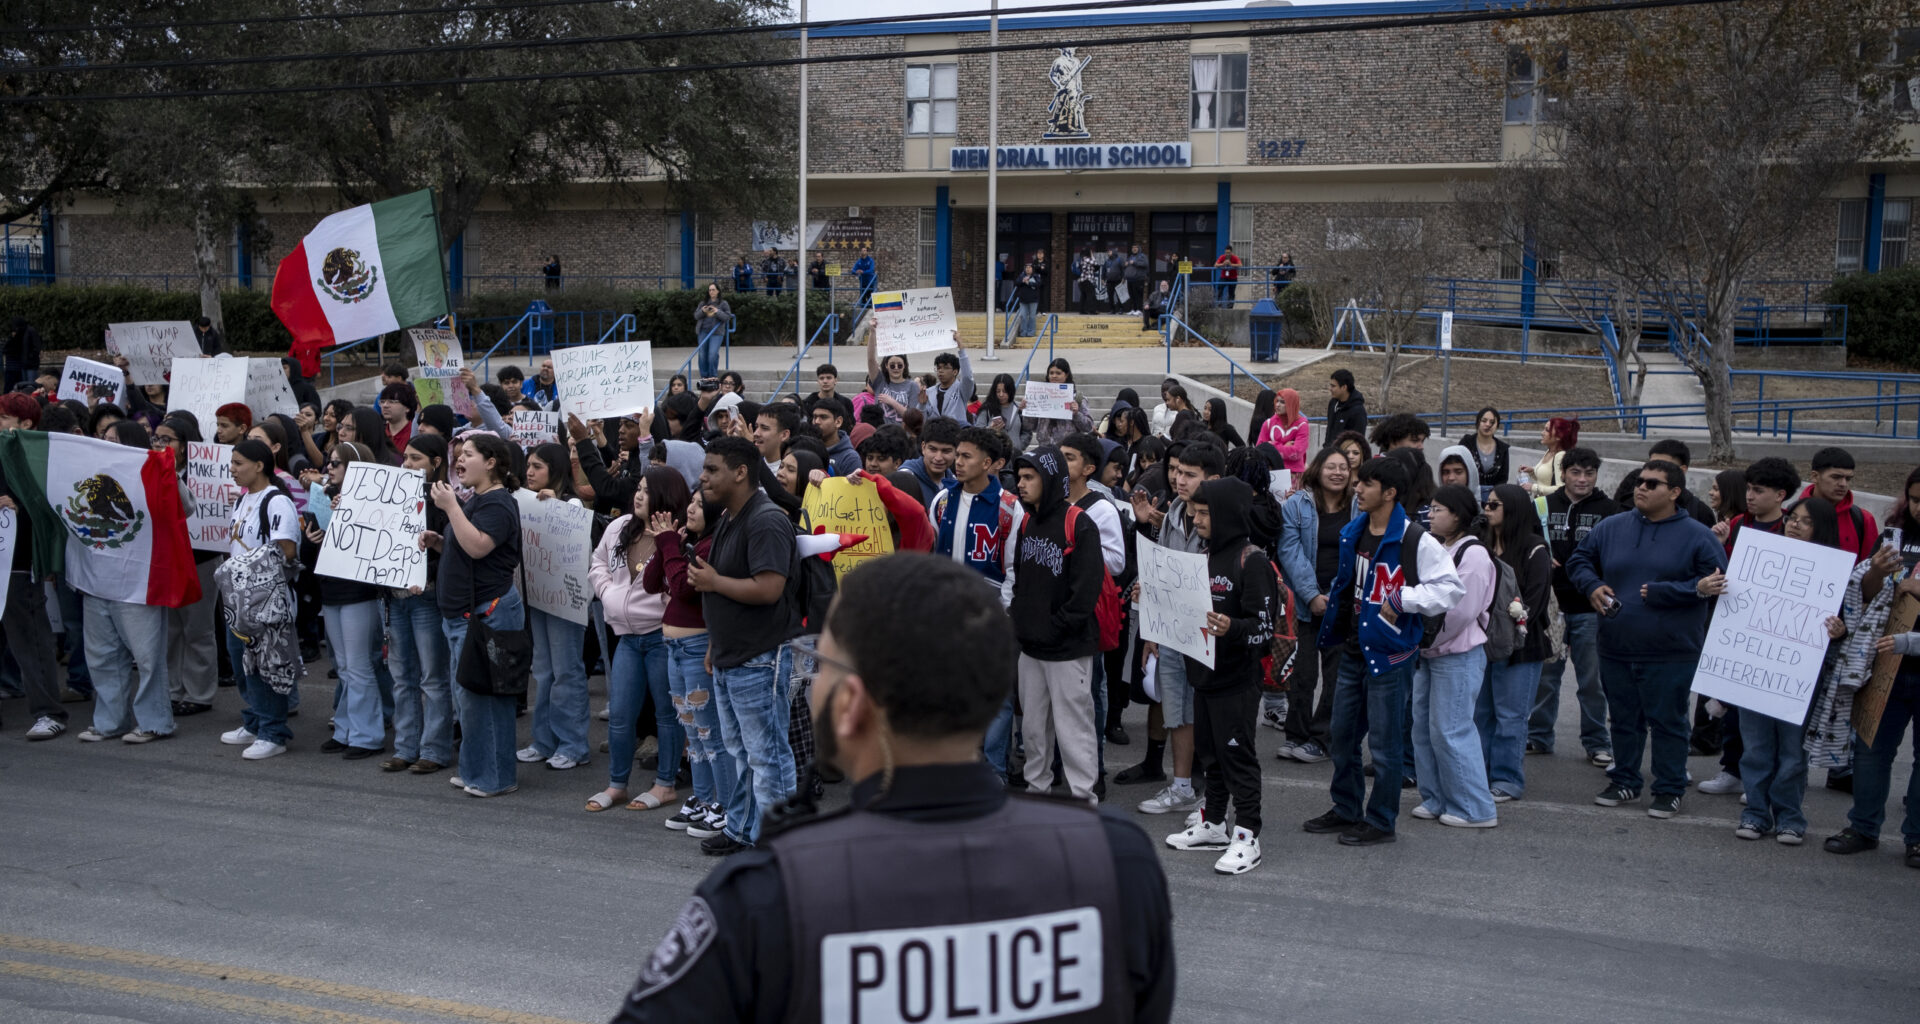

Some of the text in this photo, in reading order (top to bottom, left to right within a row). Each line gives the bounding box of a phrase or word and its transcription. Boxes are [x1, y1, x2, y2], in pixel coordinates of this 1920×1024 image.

[951, 145, 1186, 168] MEMORIAL HIGH SCHOOL
[1258, 139, 1306, 158] 1227
[1073, 223, 1128, 232] MINUTEMEN
[143, 326, 179, 342] TRUMP
[148, 341, 175, 357] KKK
[560, 349, 608, 366] DRINK
[614, 344, 639, 361] MY
[68, 369, 119, 391] AMERICAN
[180, 374, 232, 393] POWER
[556, 364, 607, 385] HORCHATA
[514, 411, 549, 424] WE ALL
[576, 397, 617, 415] ICE
[189, 462, 216, 478] MAKE
[341, 466, 407, 505] JESUS
[355, 502, 400, 530] LOVE
[834, 495, 863, 522] Get
[867, 498, 884, 524] to
[324, 521, 376, 555] NOT
[971, 523, 1000, 562] M
[354, 556, 413, 588] Them!
[1369, 562, 1406, 605] M
[1738, 545, 1835, 599] ICE IS
[1720, 588, 1834, 649] JUST KKK
[1718, 629, 1801, 666] SPELLED
[1699, 652, 1812, 698] DIFFERENTLY!
[849, 922, 1081, 1024] POLICE
